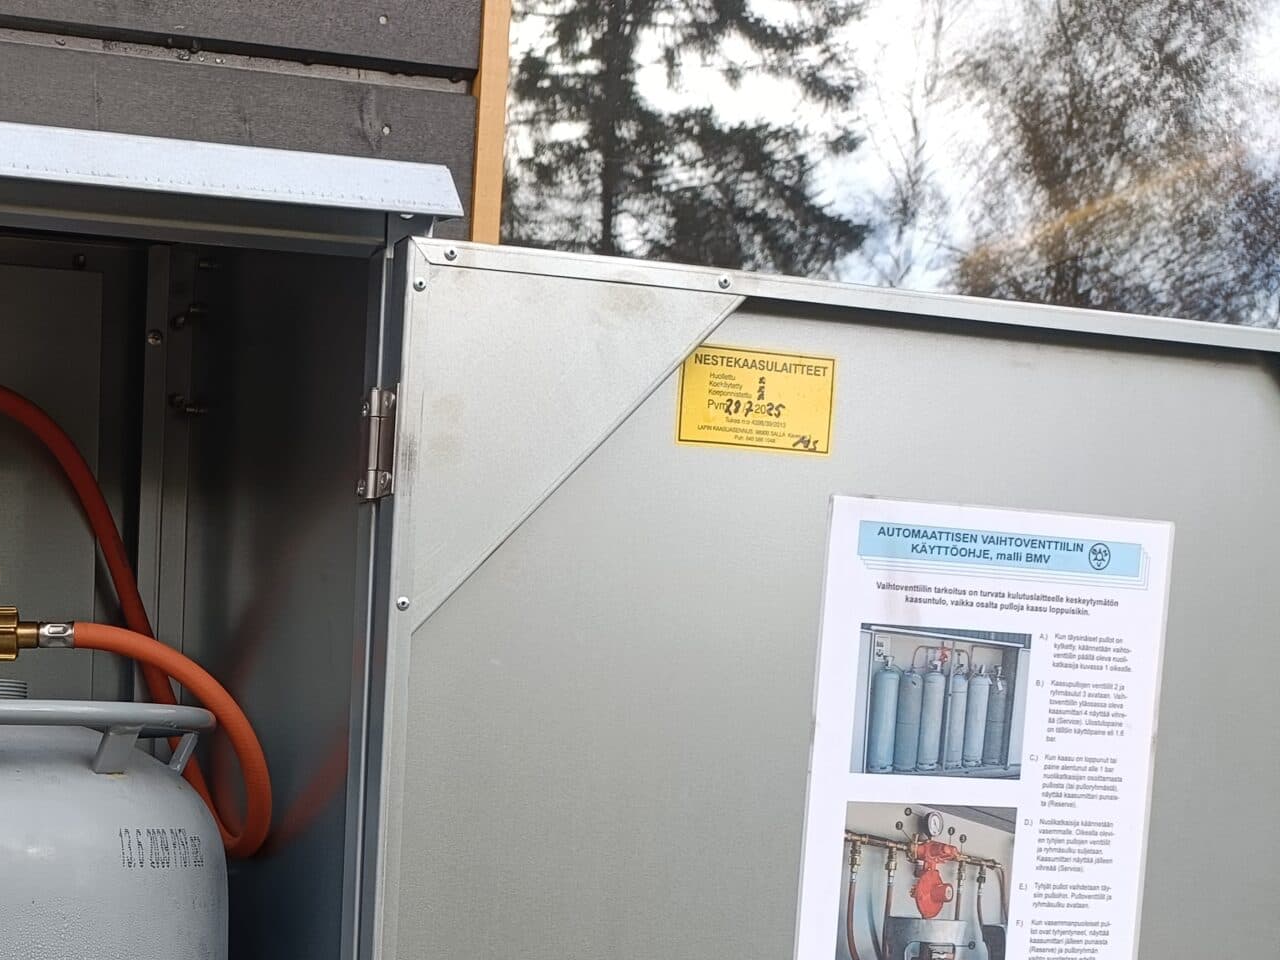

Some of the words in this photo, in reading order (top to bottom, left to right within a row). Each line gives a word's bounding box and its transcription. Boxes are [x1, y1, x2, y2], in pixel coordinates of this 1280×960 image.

[694, 353, 828, 377] NESTEKAASULAITTEET
[877, 526, 977, 543] AUTOMAATTISEN
[980, 535, 1084, 552] VAIHTOVENTTIILIN
[911, 541, 993, 560] KÄYTTÖOHJE,
[996, 550, 1022, 561] malli
[1025, 553, 1050, 563] BMV
[875, 581, 931, 592] Vaihtoventtiilin
[934, 586, 966, 595] tarkoitus
[979, 590, 1005, 598] turvata
[1007, 591, 1063, 602] kulutuslaitteelle
[1065, 595, 1119, 608] keskeytymätön
[904, 595, 948, 606] kaasuntulo,
[950, 598, 973, 607] vaikka
[975, 600, 997, 609] osalta
[999, 601, 1024, 612] pulloja
[1026, 604, 1047, 612] kaasu
[1048, 605, 1089, 616] loppuisikin.
